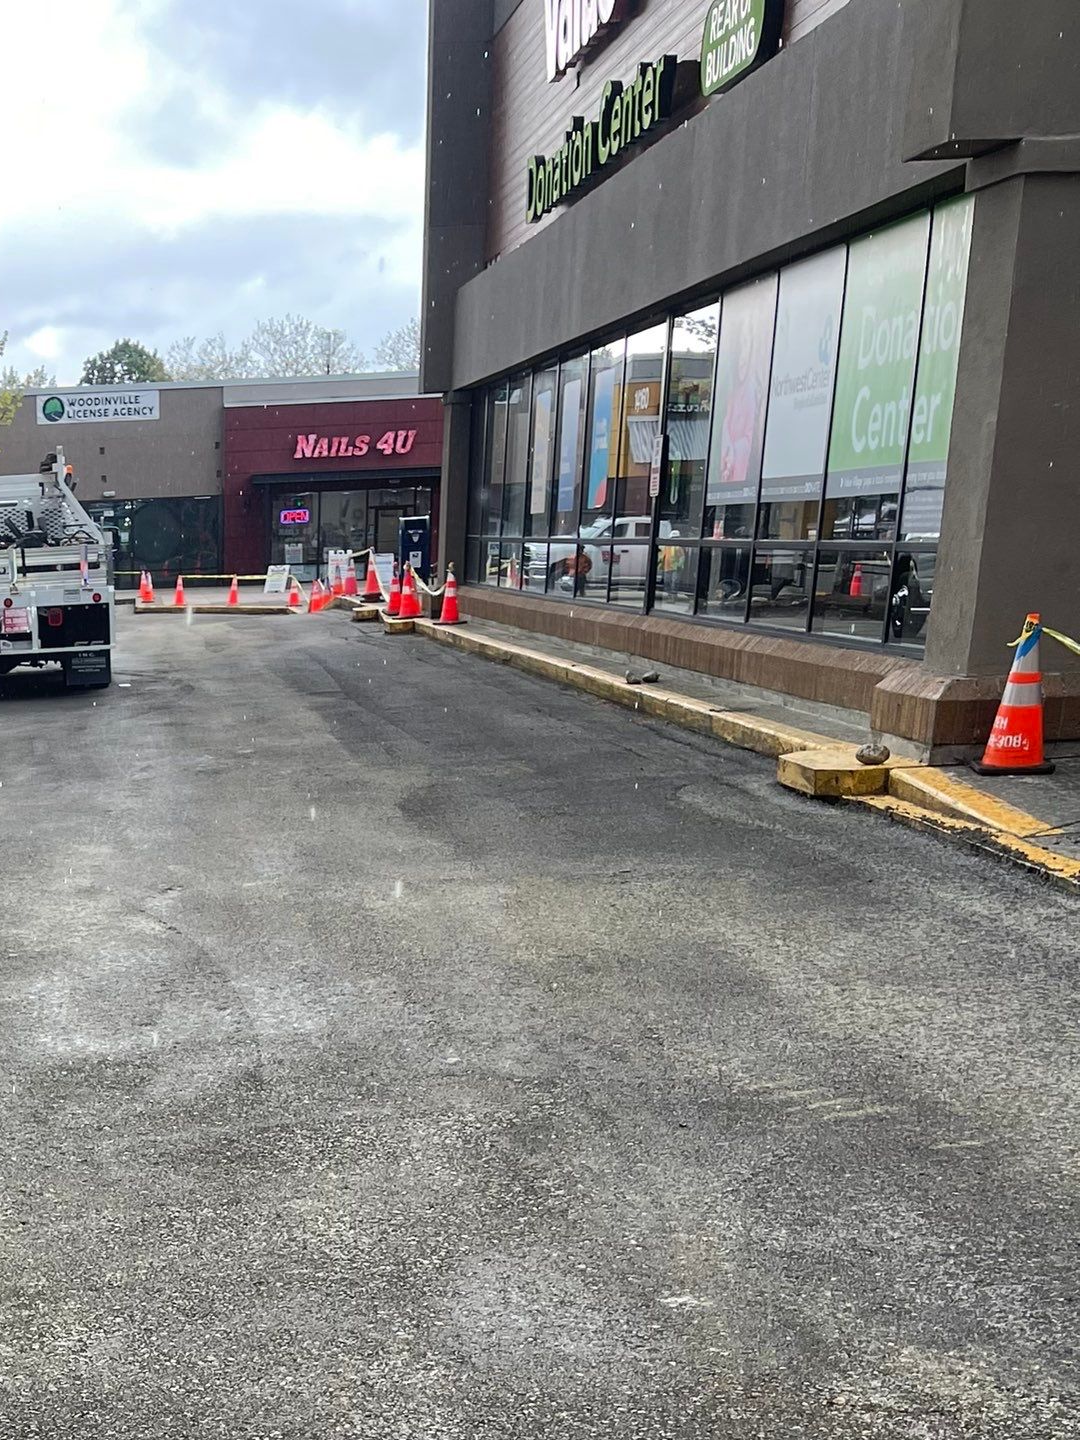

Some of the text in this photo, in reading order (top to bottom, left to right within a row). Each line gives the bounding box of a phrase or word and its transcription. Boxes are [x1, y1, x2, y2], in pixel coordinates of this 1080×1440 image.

[710, 0, 739, 44] REAR
[705, 17, 755, 88] BUILDING
[526, 57, 665, 224] Donation Center
[857, 299, 959, 370] Donatio
[67, 395, 140, 407] WOODINVILLE
[67, 406, 154, 419] LICENSE AGENCY
[851, 386, 942, 453] Center
[293, 429, 417, 459] NAILS 4U
